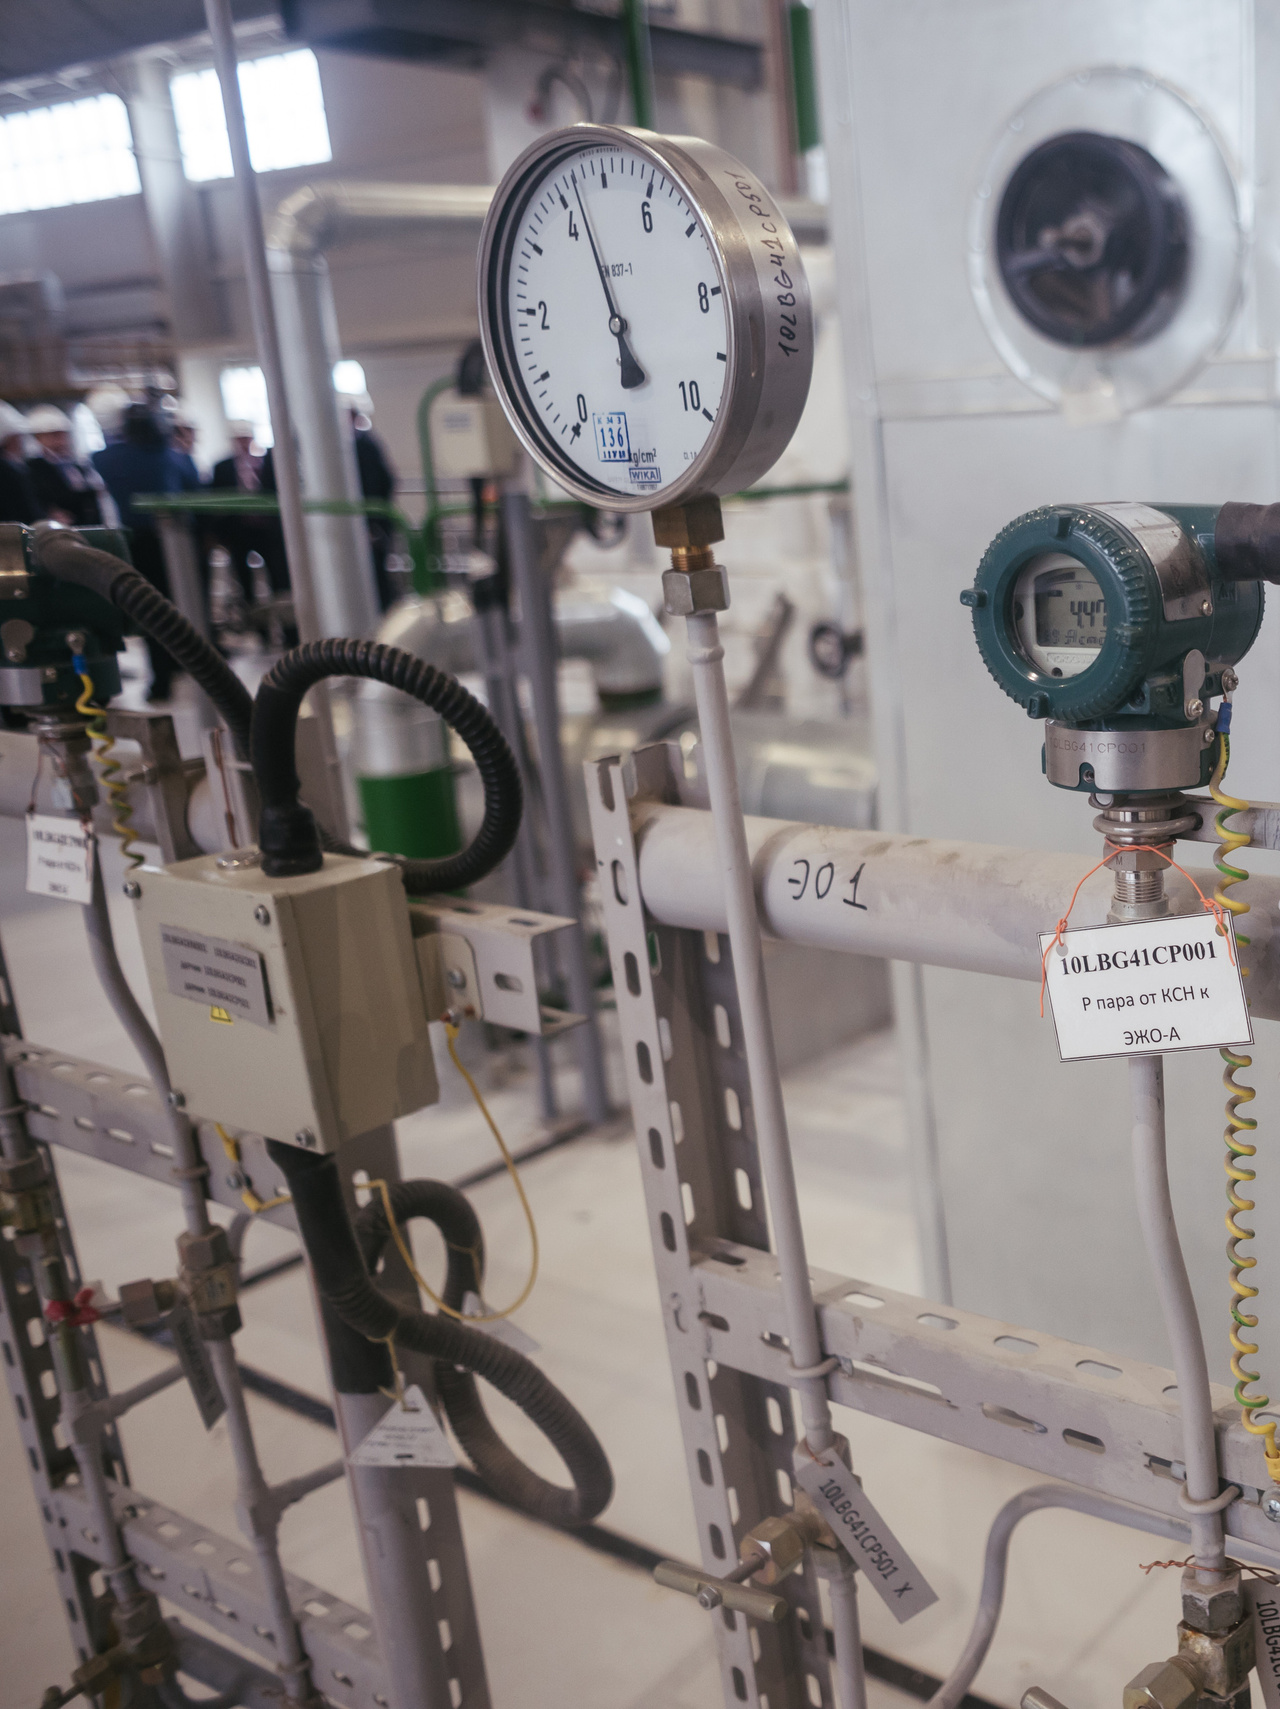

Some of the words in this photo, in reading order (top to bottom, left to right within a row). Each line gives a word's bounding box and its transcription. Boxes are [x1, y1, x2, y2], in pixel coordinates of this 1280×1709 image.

[568, 210, 580, 241] 4
[641, 201, 653, 234] 6
[611, 262, 633, 277] 837-1
[697, 281, 710, 314] 8
[538, 300, 550, 330] 2
[576, 393, 588, 423] 0
[678, 380, 701, 412] 10
[631, 470, 657, 481] WIKA
[1060, 940, 1218, 976] 10LBG41CP001
[1082, 996, 1091, 1012] Р
[1096, 995, 1135, 1012] пара
[1139, 992, 1157, 1006] от
[1161, 985, 1195, 1004] КСН
[1200, 987, 1210, 1000] к
[1123, 1026, 1181, 1046] ЭЖО-А
[818, 1478, 899, 1581] 10LBG41CP501
